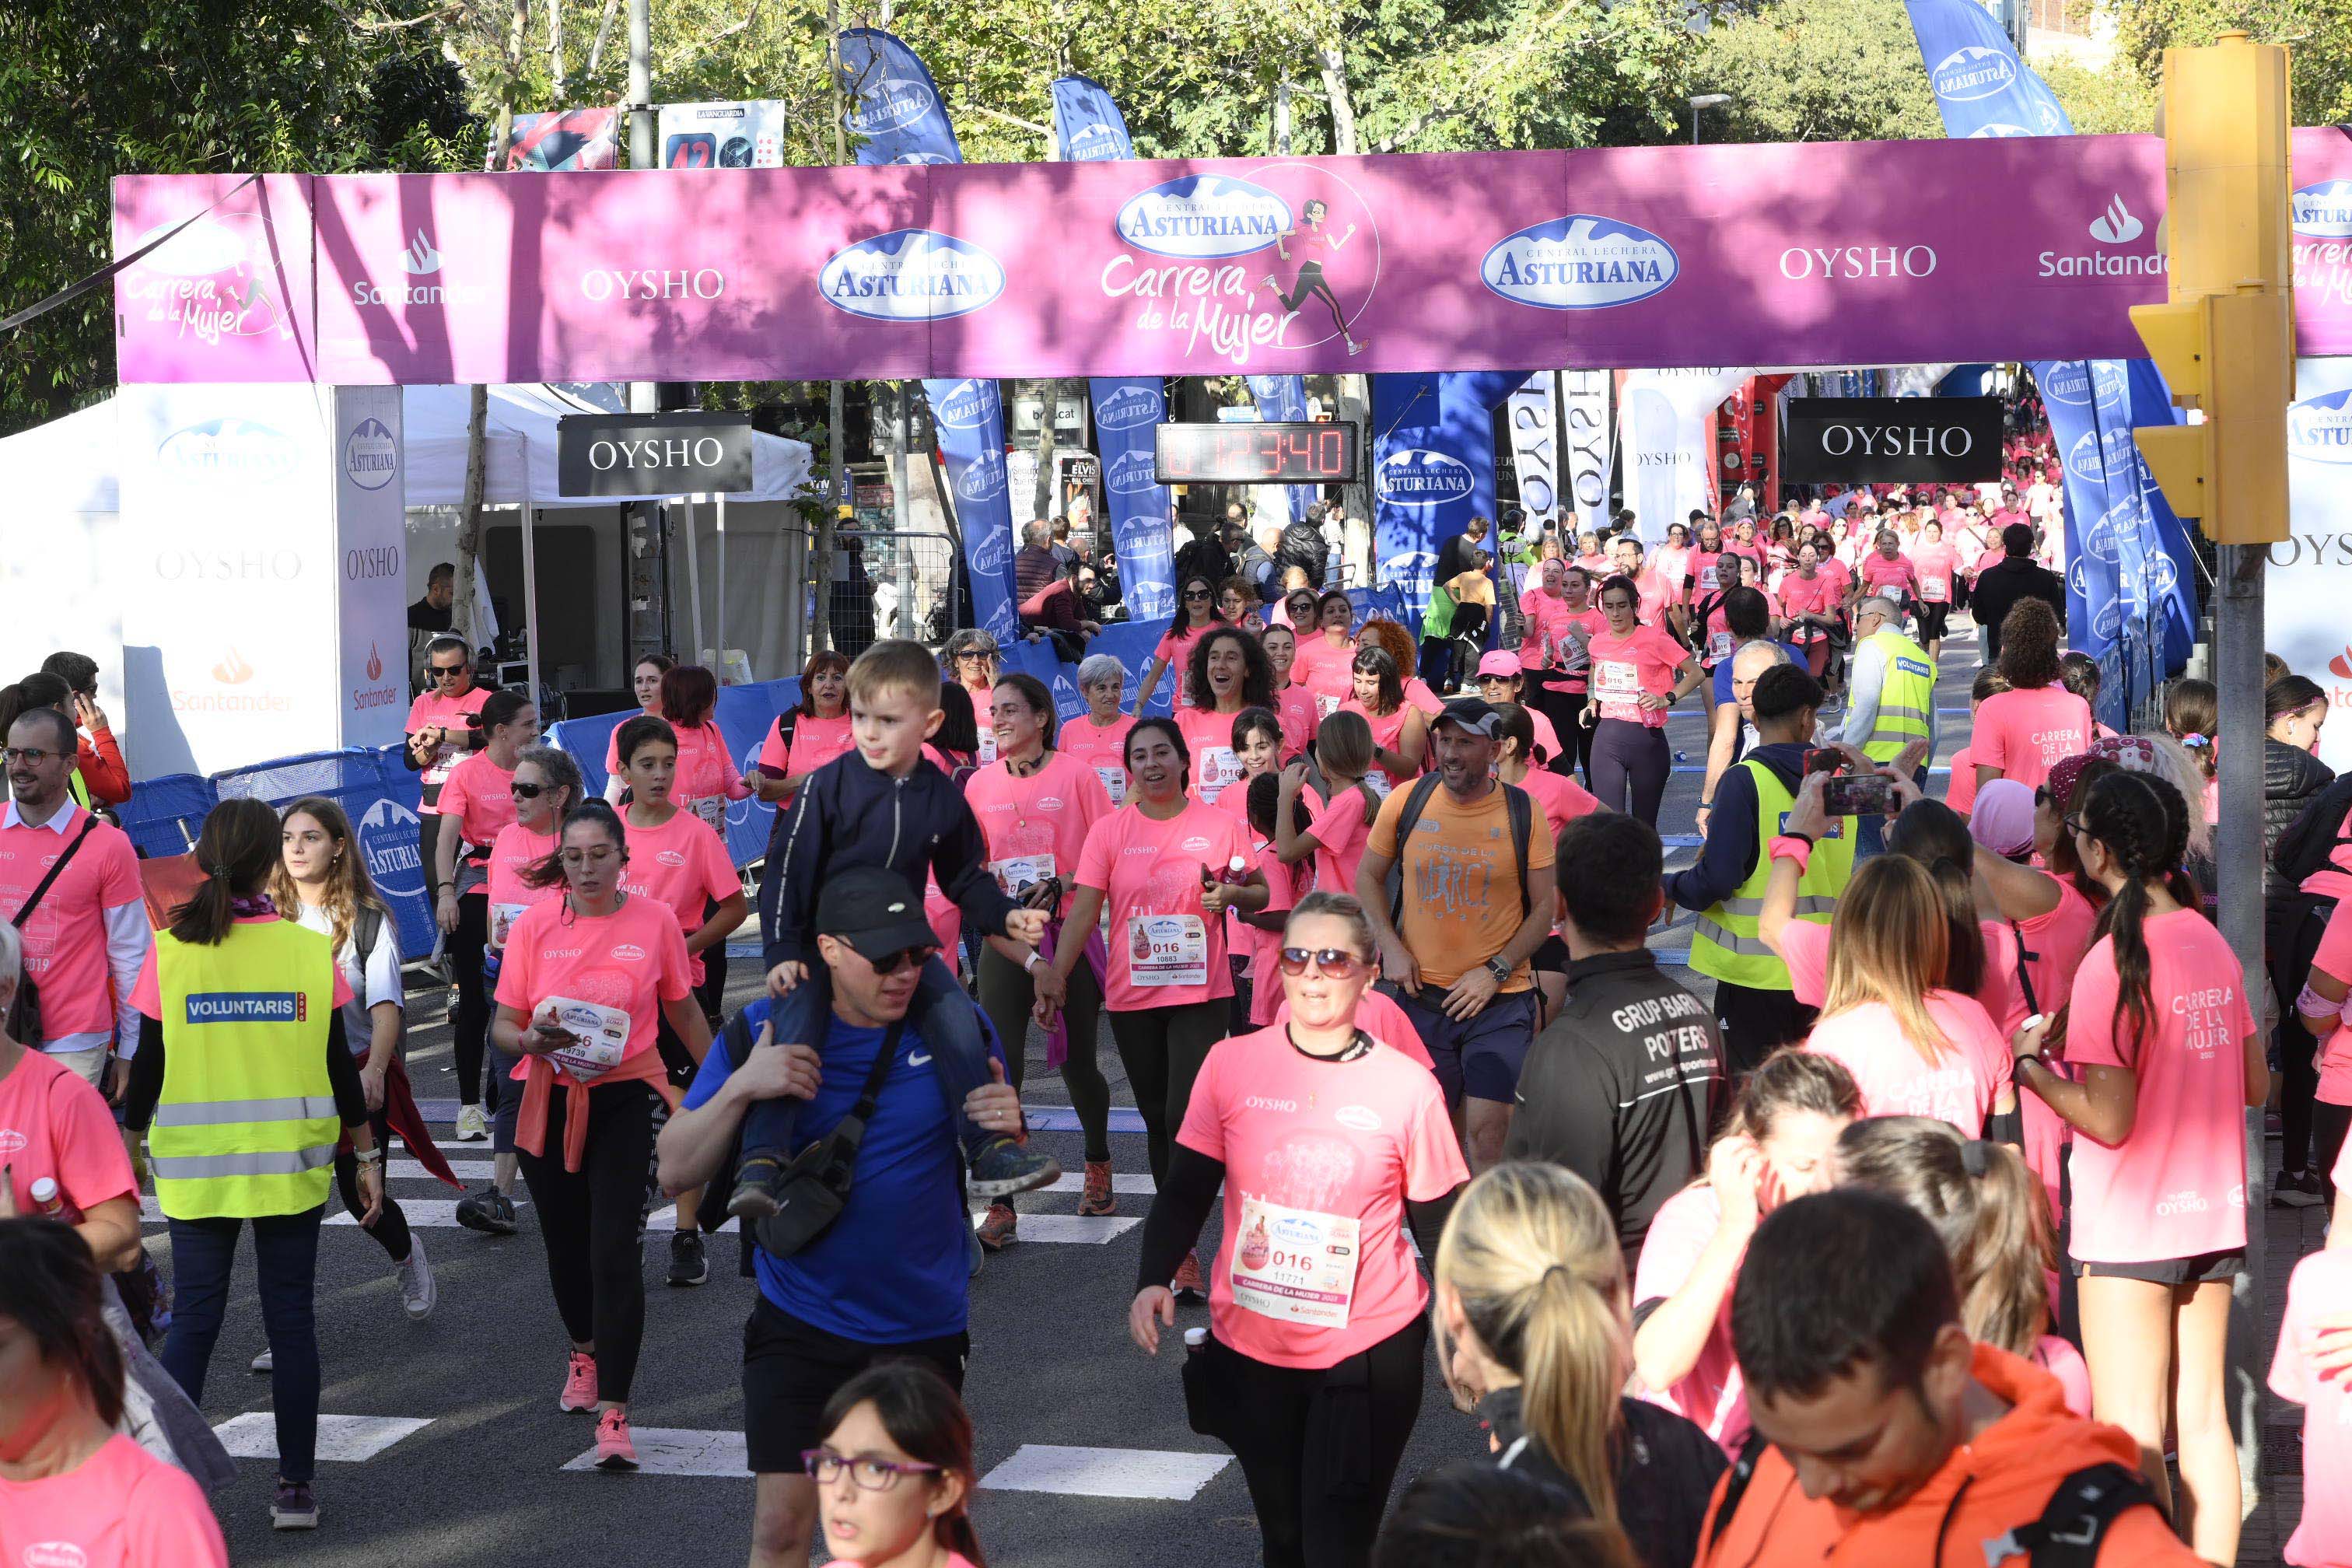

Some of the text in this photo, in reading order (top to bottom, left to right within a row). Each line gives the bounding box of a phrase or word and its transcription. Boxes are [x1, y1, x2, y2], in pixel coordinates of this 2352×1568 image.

[1130, 205, 1279, 236] ASTURIANA
[1527, 246, 1657, 257] CENTRAL LECHERA
[1496, 251, 1664, 285] ASTURIANA
[1779, 245, 1937, 280] OYSHO
[2039, 251, 2167, 277] Santand
[125, 271, 216, 299] Carrera
[582, 268, 725, 301] OYSHO
[833, 263, 990, 297] ASTURIANA
[1101, 254, 1246, 298] Carrera
[179, 297, 250, 346] Mujer
[1136, 292, 1300, 365] de la Mujer
[1822, 425, 1972, 457] OYSHO
[349, 446, 394, 471] ASTURIANA
[589, 437, 723, 470] OYSHO
[1632, 451, 1691, 467] OYSHO
[1072, 465, 1096, 475] ELVIS
[1378, 472, 1466, 493] ASTURIANA
[155, 549, 303, 580] OYSHO
[347, 545, 398, 581] OYSHO
[172, 690, 292, 711] Santander
[354, 687, 397, 711] Santander
[2032, 730, 2081, 744] CARRERA
[2042, 743, 2072, 754] DE LA
[1220, 768, 1241, 778] 016
[481, 793, 508, 802] OYSHO
[988, 803, 1014, 813] OYSHO
[373, 833, 398, 845] CENTRAL
[366, 839, 422, 876] ASTURIA
[1124, 845, 1157, 856] OYSHO
[1461, 848, 1478, 856] DE
[1006, 866, 1034, 875] ASTURIANA
[1150, 926, 1181, 935] ASTURIANA
[544, 949, 582, 959] OYSHO
[612, 949, 646, 959] ASTURIANA
[1153, 943, 1180, 954] 016
[24, 957, 50, 971] 2019
[189, 999, 293, 1016] VOLUNTARIS
[2172, 986, 2234, 1014] CARRERA
[565, 1011, 601, 1027] ASTURIANA
[1612, 999, 1662, 1033] GRUP
[2186, 1010, 2224, 1031] DE LA
[2186, 1027, 2231, 1050] MUJER
[562, 1047, 586, 1058] 19739
[1889, 1069, 1975, 1100] CARRERA
[1246, 1095, 1297, 1113] OYSHO
[1934, 1093, 1959, 1108] LA
[2156, 1198, 2208, 1216] OYSHO
[1276, 1224, 1319, 1241] ASTURIANA
[1272, 1251, 1312, 1271] 016
[1274, 1271, 1304, 1286] 11771
[1243, 1279, 1273, 1292] CARRERA
[1273, 1285, 1283, 1294] DE
[1284, 1287, 1294, 1296] LA
[1294, 1290, 1320, 1300] MUJER
[1241, 1292, 1339, 1318] OYSHO Santander
